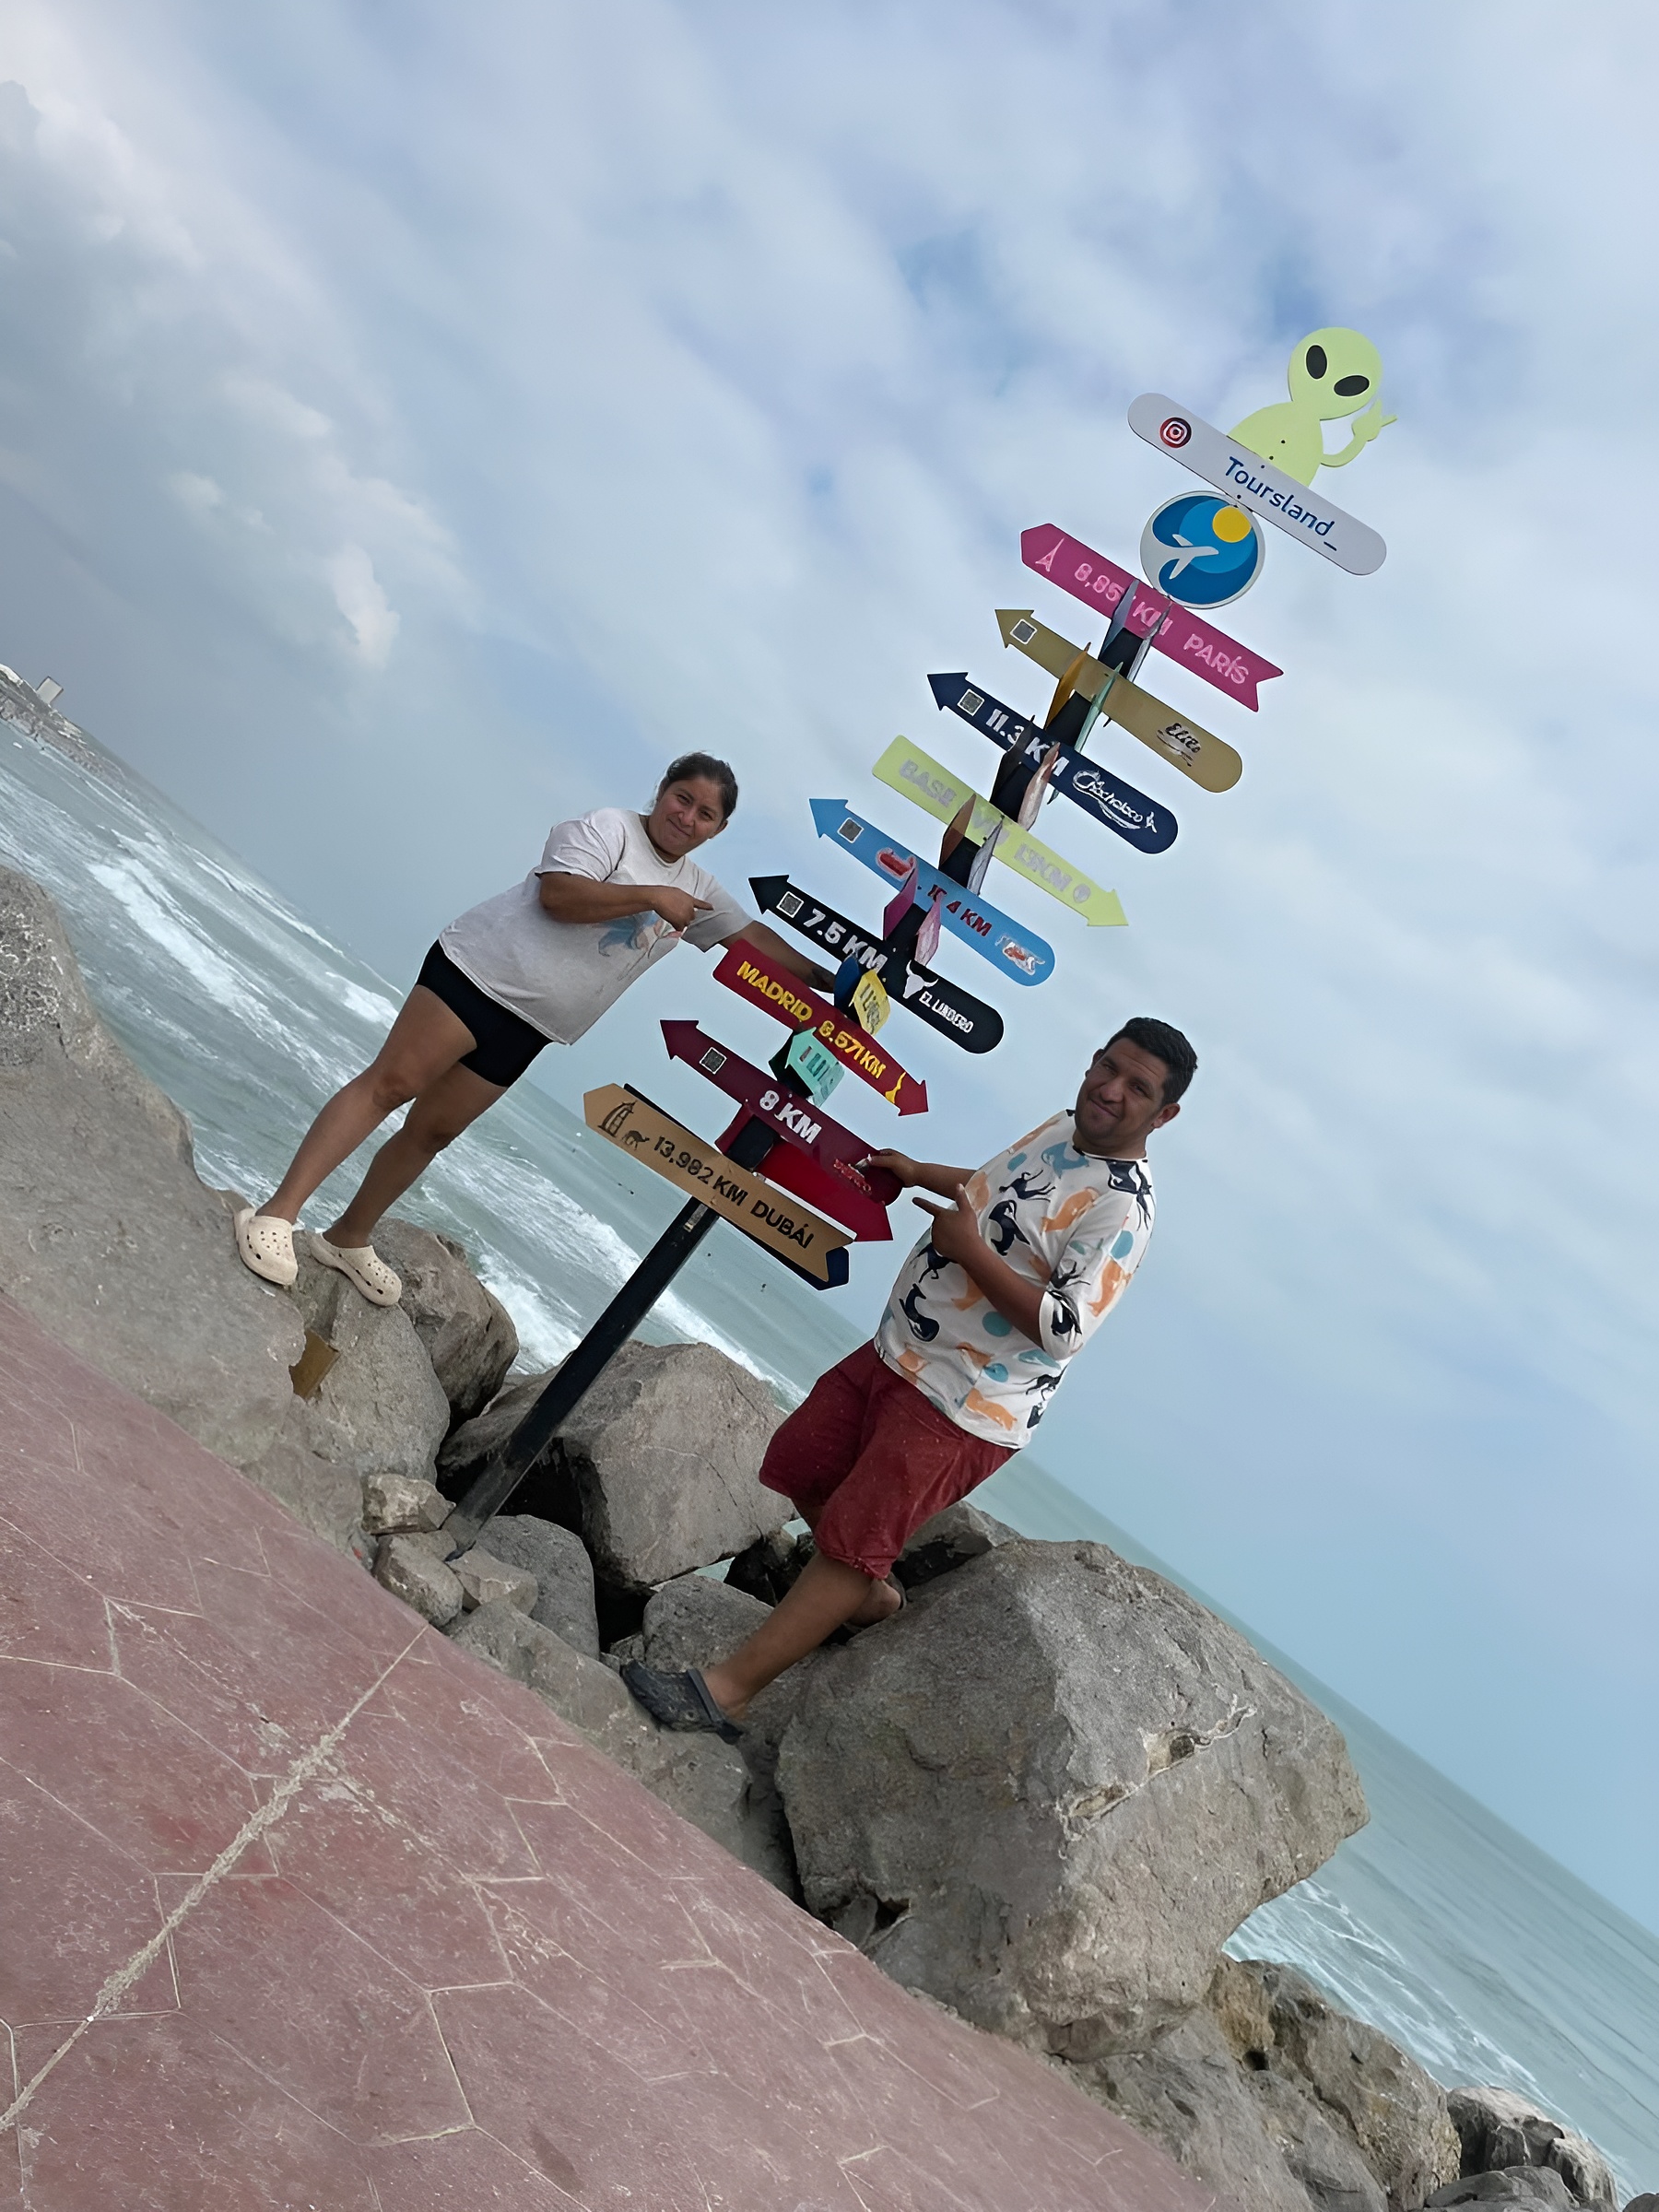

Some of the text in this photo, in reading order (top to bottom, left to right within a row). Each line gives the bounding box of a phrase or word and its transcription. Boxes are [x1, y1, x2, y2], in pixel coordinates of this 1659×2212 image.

[1183, 633, 1249, 684] PARÍS
[803, 908, 888, 973] 7.5 KM
[960, 908, 992, 936] KM
[736, 960, 813, 1021] MADRID
[919, 990, 934, 1006] EL
[759, 1089, 823, 1145] 8 KM
[712, 1175, 749, 1207] KM
[750, 1200, 815, 1250] DUBÁI
